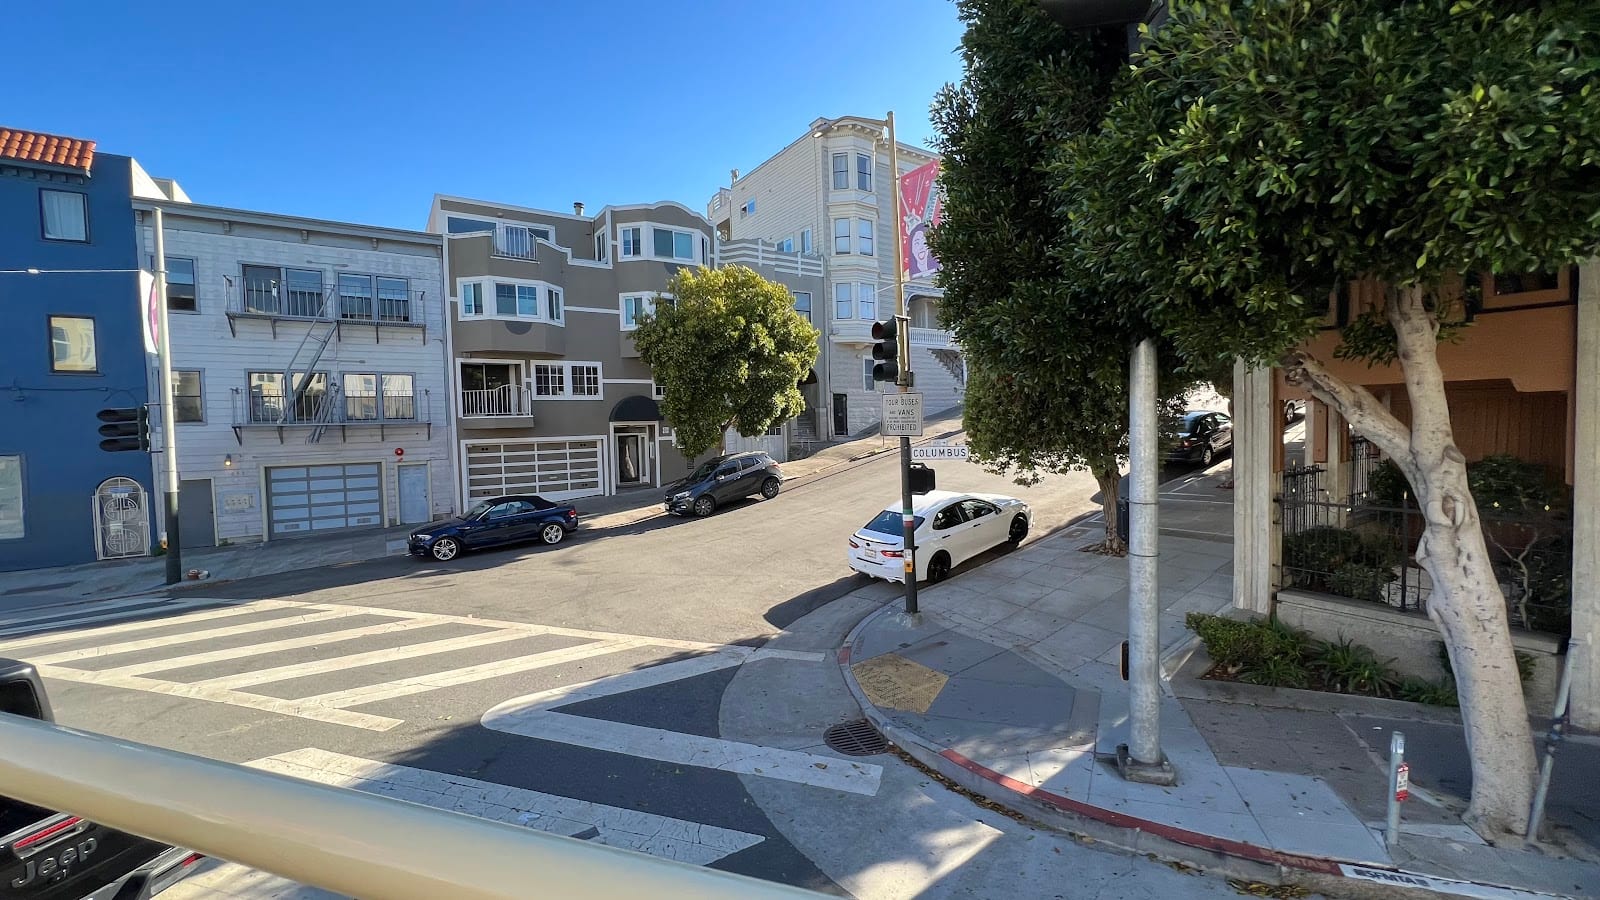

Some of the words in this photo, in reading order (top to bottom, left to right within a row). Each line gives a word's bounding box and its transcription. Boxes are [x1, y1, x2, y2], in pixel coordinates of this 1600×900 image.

[901, 398, 919, 406] BUSES
[887, 423, 917, 431] PROHIBITED
[913, 448, 966, 458] COLUMBUS
[11, 837, 98, 888] Jeep
[1366, 870, 1417, 885] SFMTA
